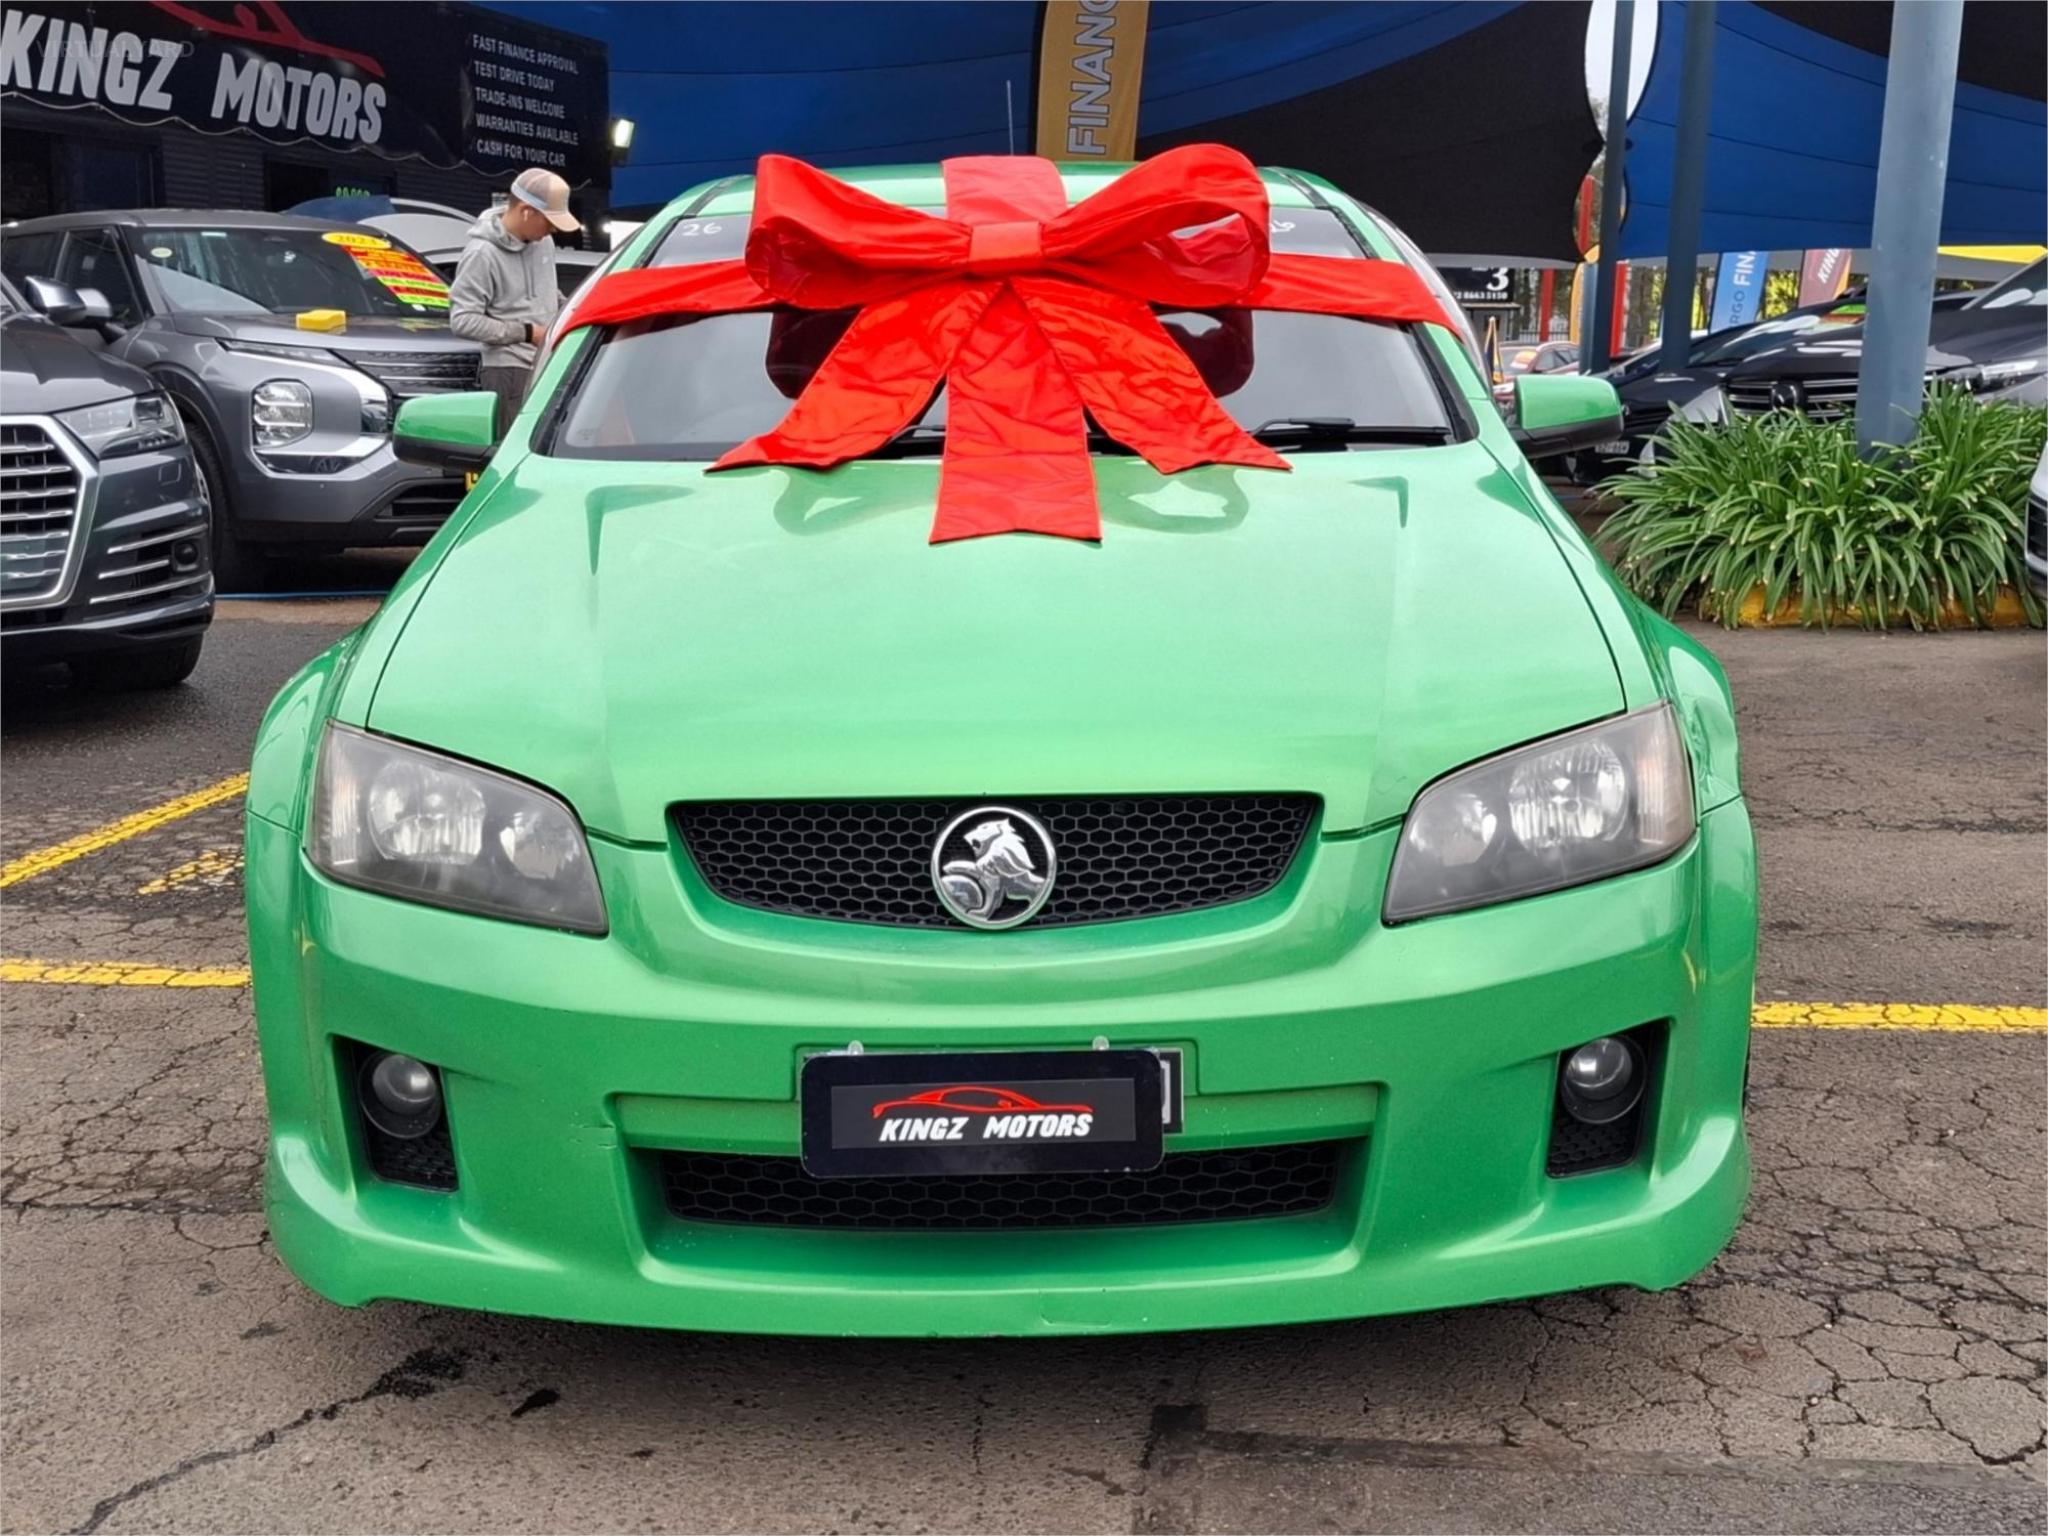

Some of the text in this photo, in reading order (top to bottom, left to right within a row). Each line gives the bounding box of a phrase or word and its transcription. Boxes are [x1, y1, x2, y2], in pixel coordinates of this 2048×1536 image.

[473, 34, 579, 75] FAST FINANCE APPROVAL
[0, 9, 387, 144] KINGZ MOTORS
[474, 60, 554, 92] TEST DRIVE TODAY
[475, 87, 565, 119] TRADE-INS WELCOME
[475, 113, 579, 145] WARRANTIES AVAILABLE
[476, 139, 566, 166] CASH FOR YOUR CAR
[682, 222, 723, 236] 26
[1733, 251, 1756, 286] FIN
[879, 1114, 1093, 1141] KINGZ MOTORS
